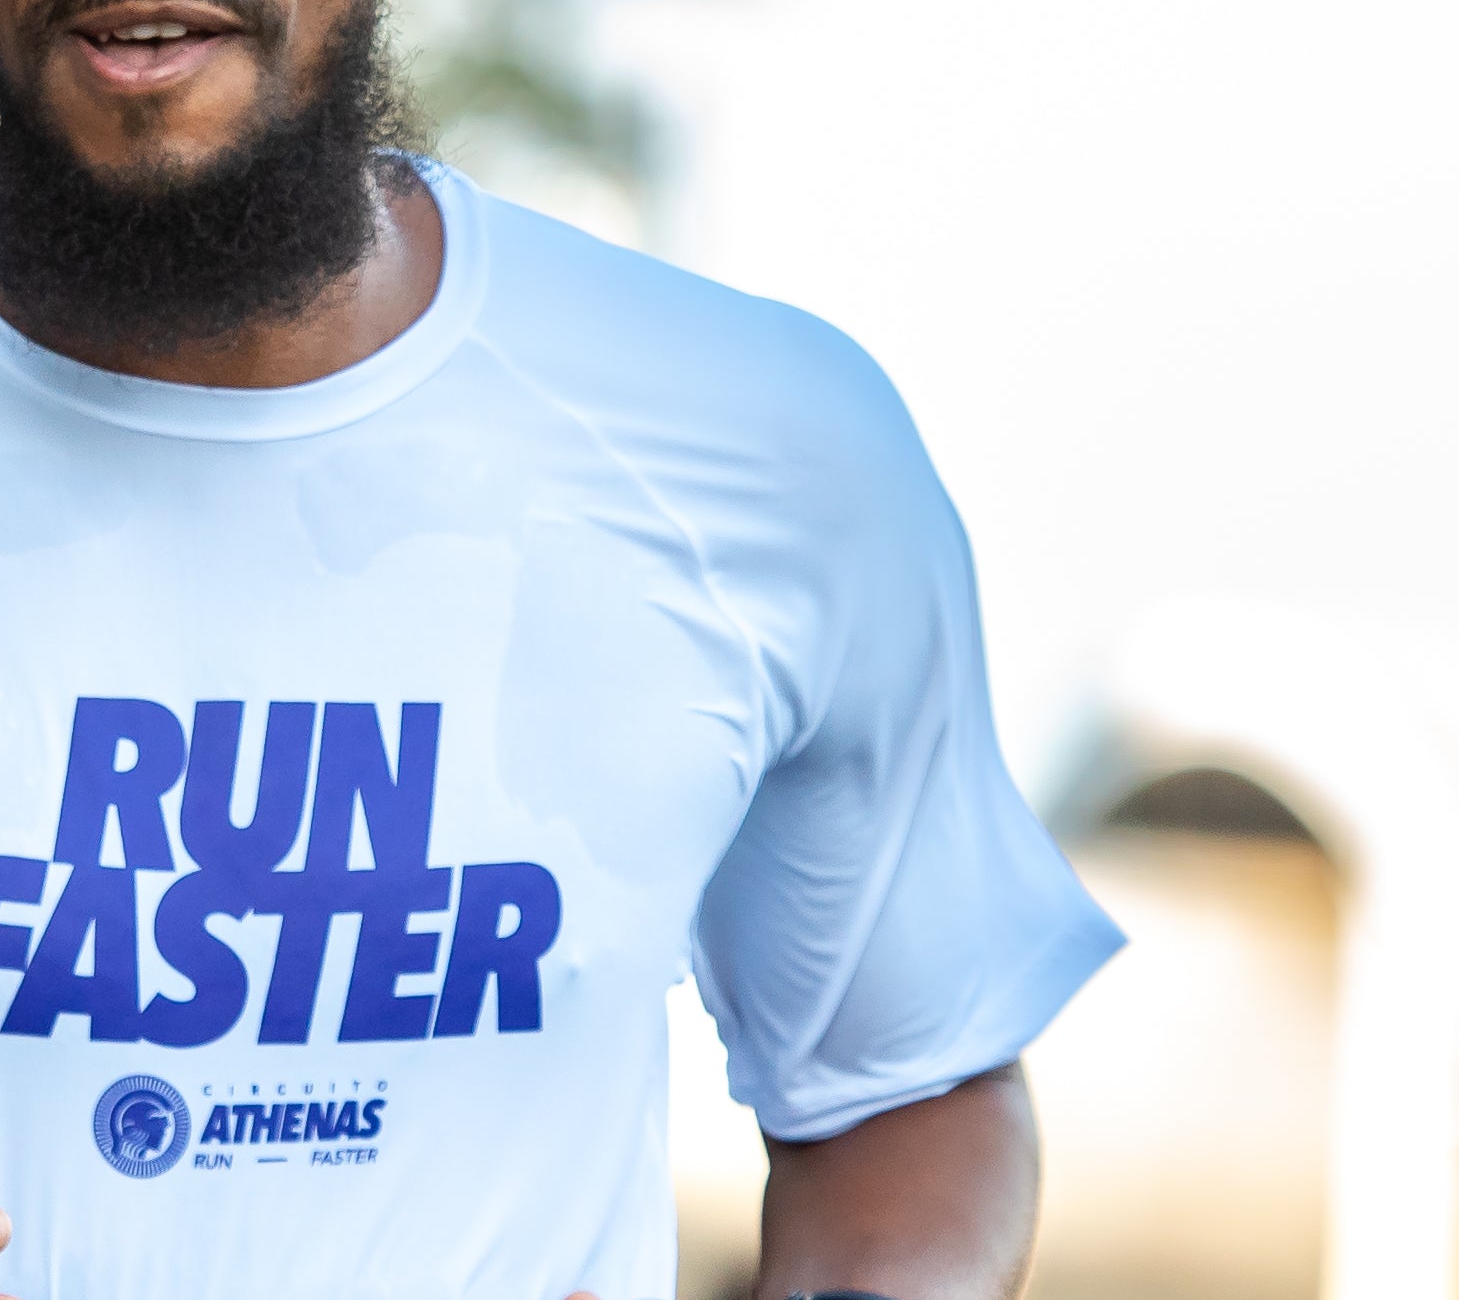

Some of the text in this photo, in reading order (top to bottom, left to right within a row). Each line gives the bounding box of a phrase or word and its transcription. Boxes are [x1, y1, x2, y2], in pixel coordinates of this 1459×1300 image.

[53, 697, 441, 873] RUN
[200, 1079, 388, 1097] CIRCUITO
[199, 1099, 387, 1145] ATHENAS
[194, 1148, 380, 1170] RUN FASTER
